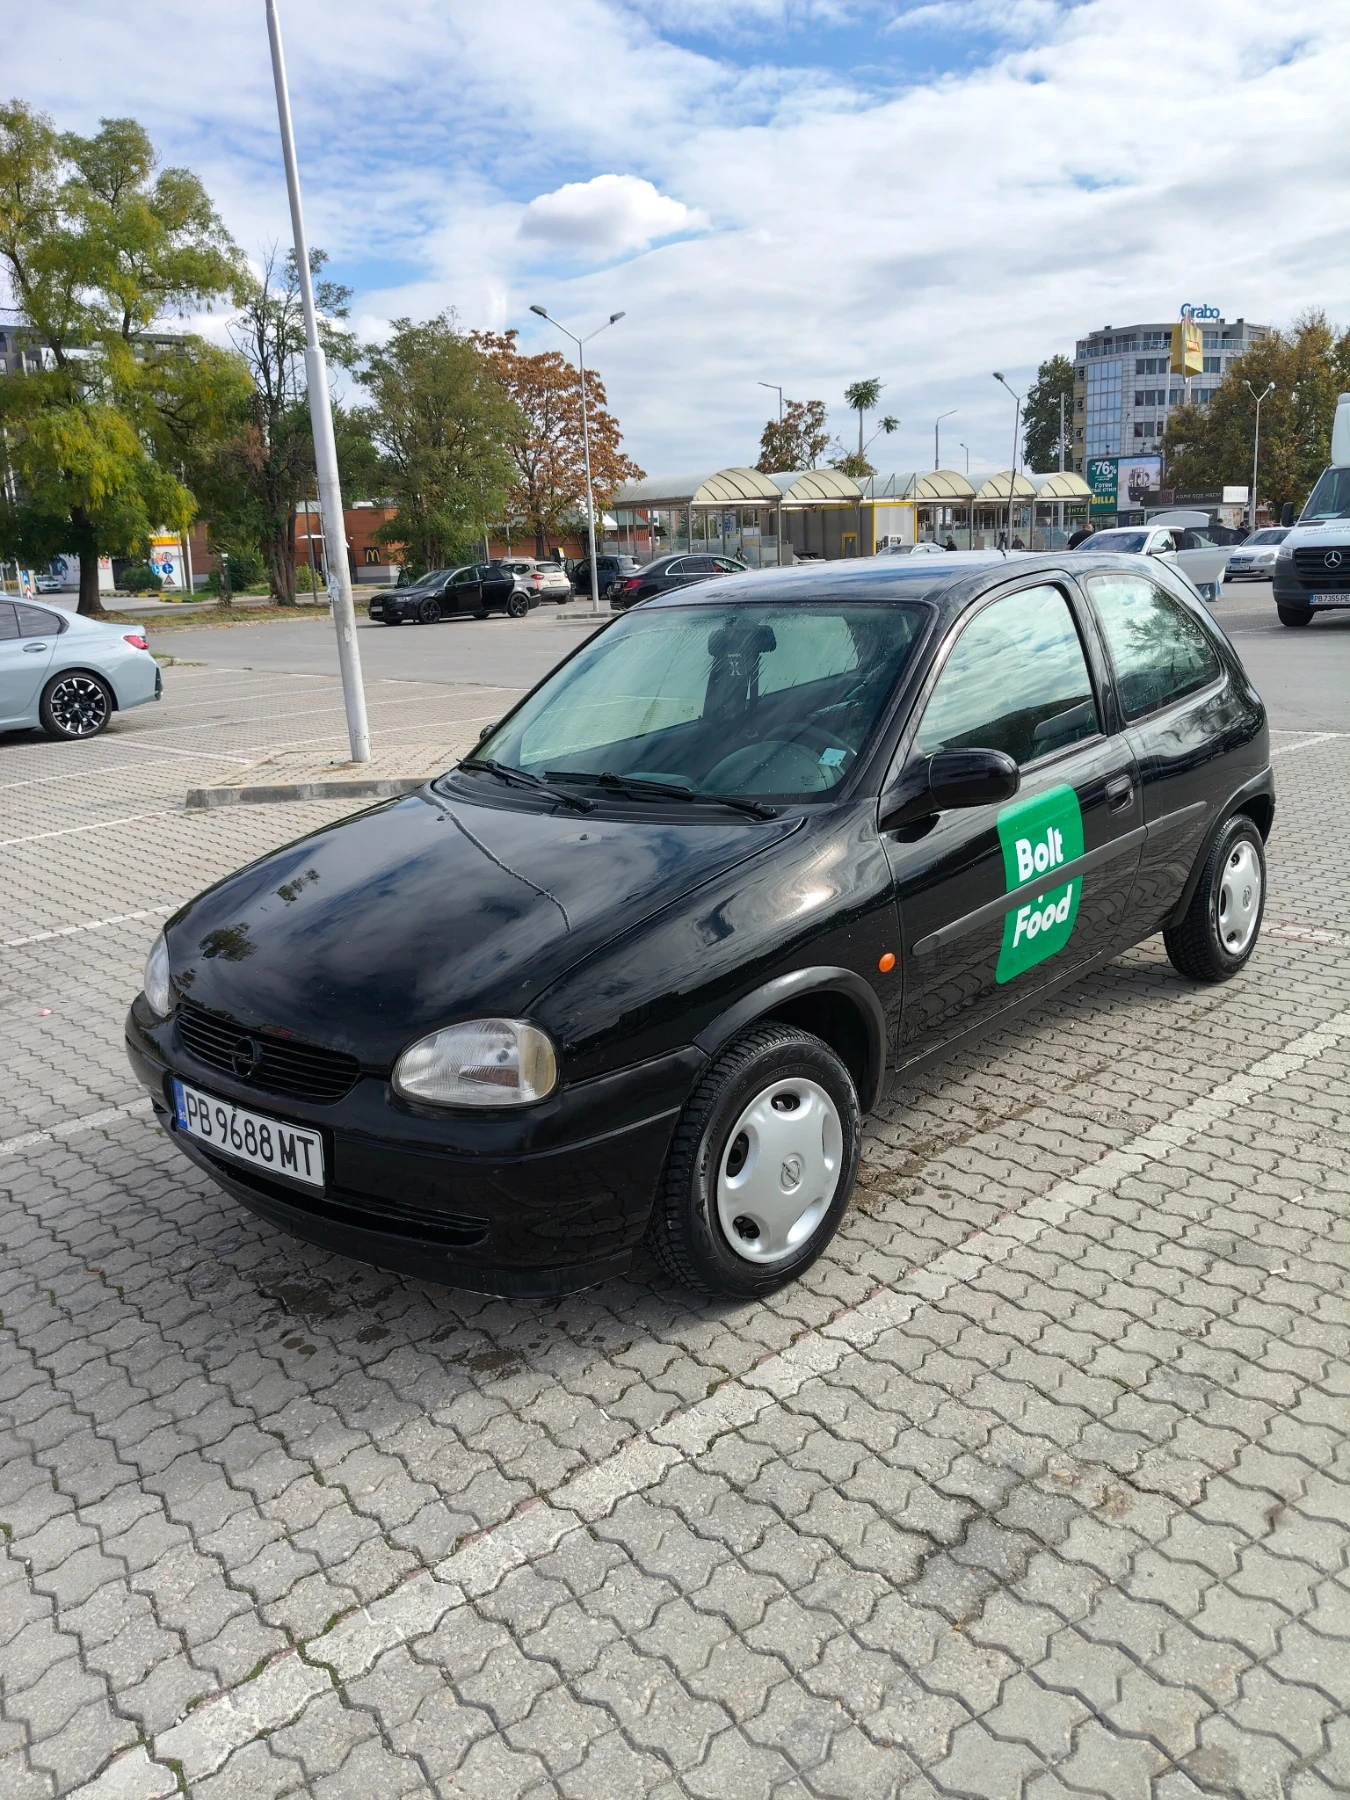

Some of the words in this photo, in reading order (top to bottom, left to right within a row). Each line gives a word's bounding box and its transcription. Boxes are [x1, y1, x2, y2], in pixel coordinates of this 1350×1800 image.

[1091, 496, 1115, 504] BILLA
[1015, 826, 1064, 883] Bolt
[1012, 883, 1073, 948] Food
[185, 1091, 213, 1137] PB
[215, 1107, 274, 1163] 9688
[278, 1129, 315, 1177] MT
